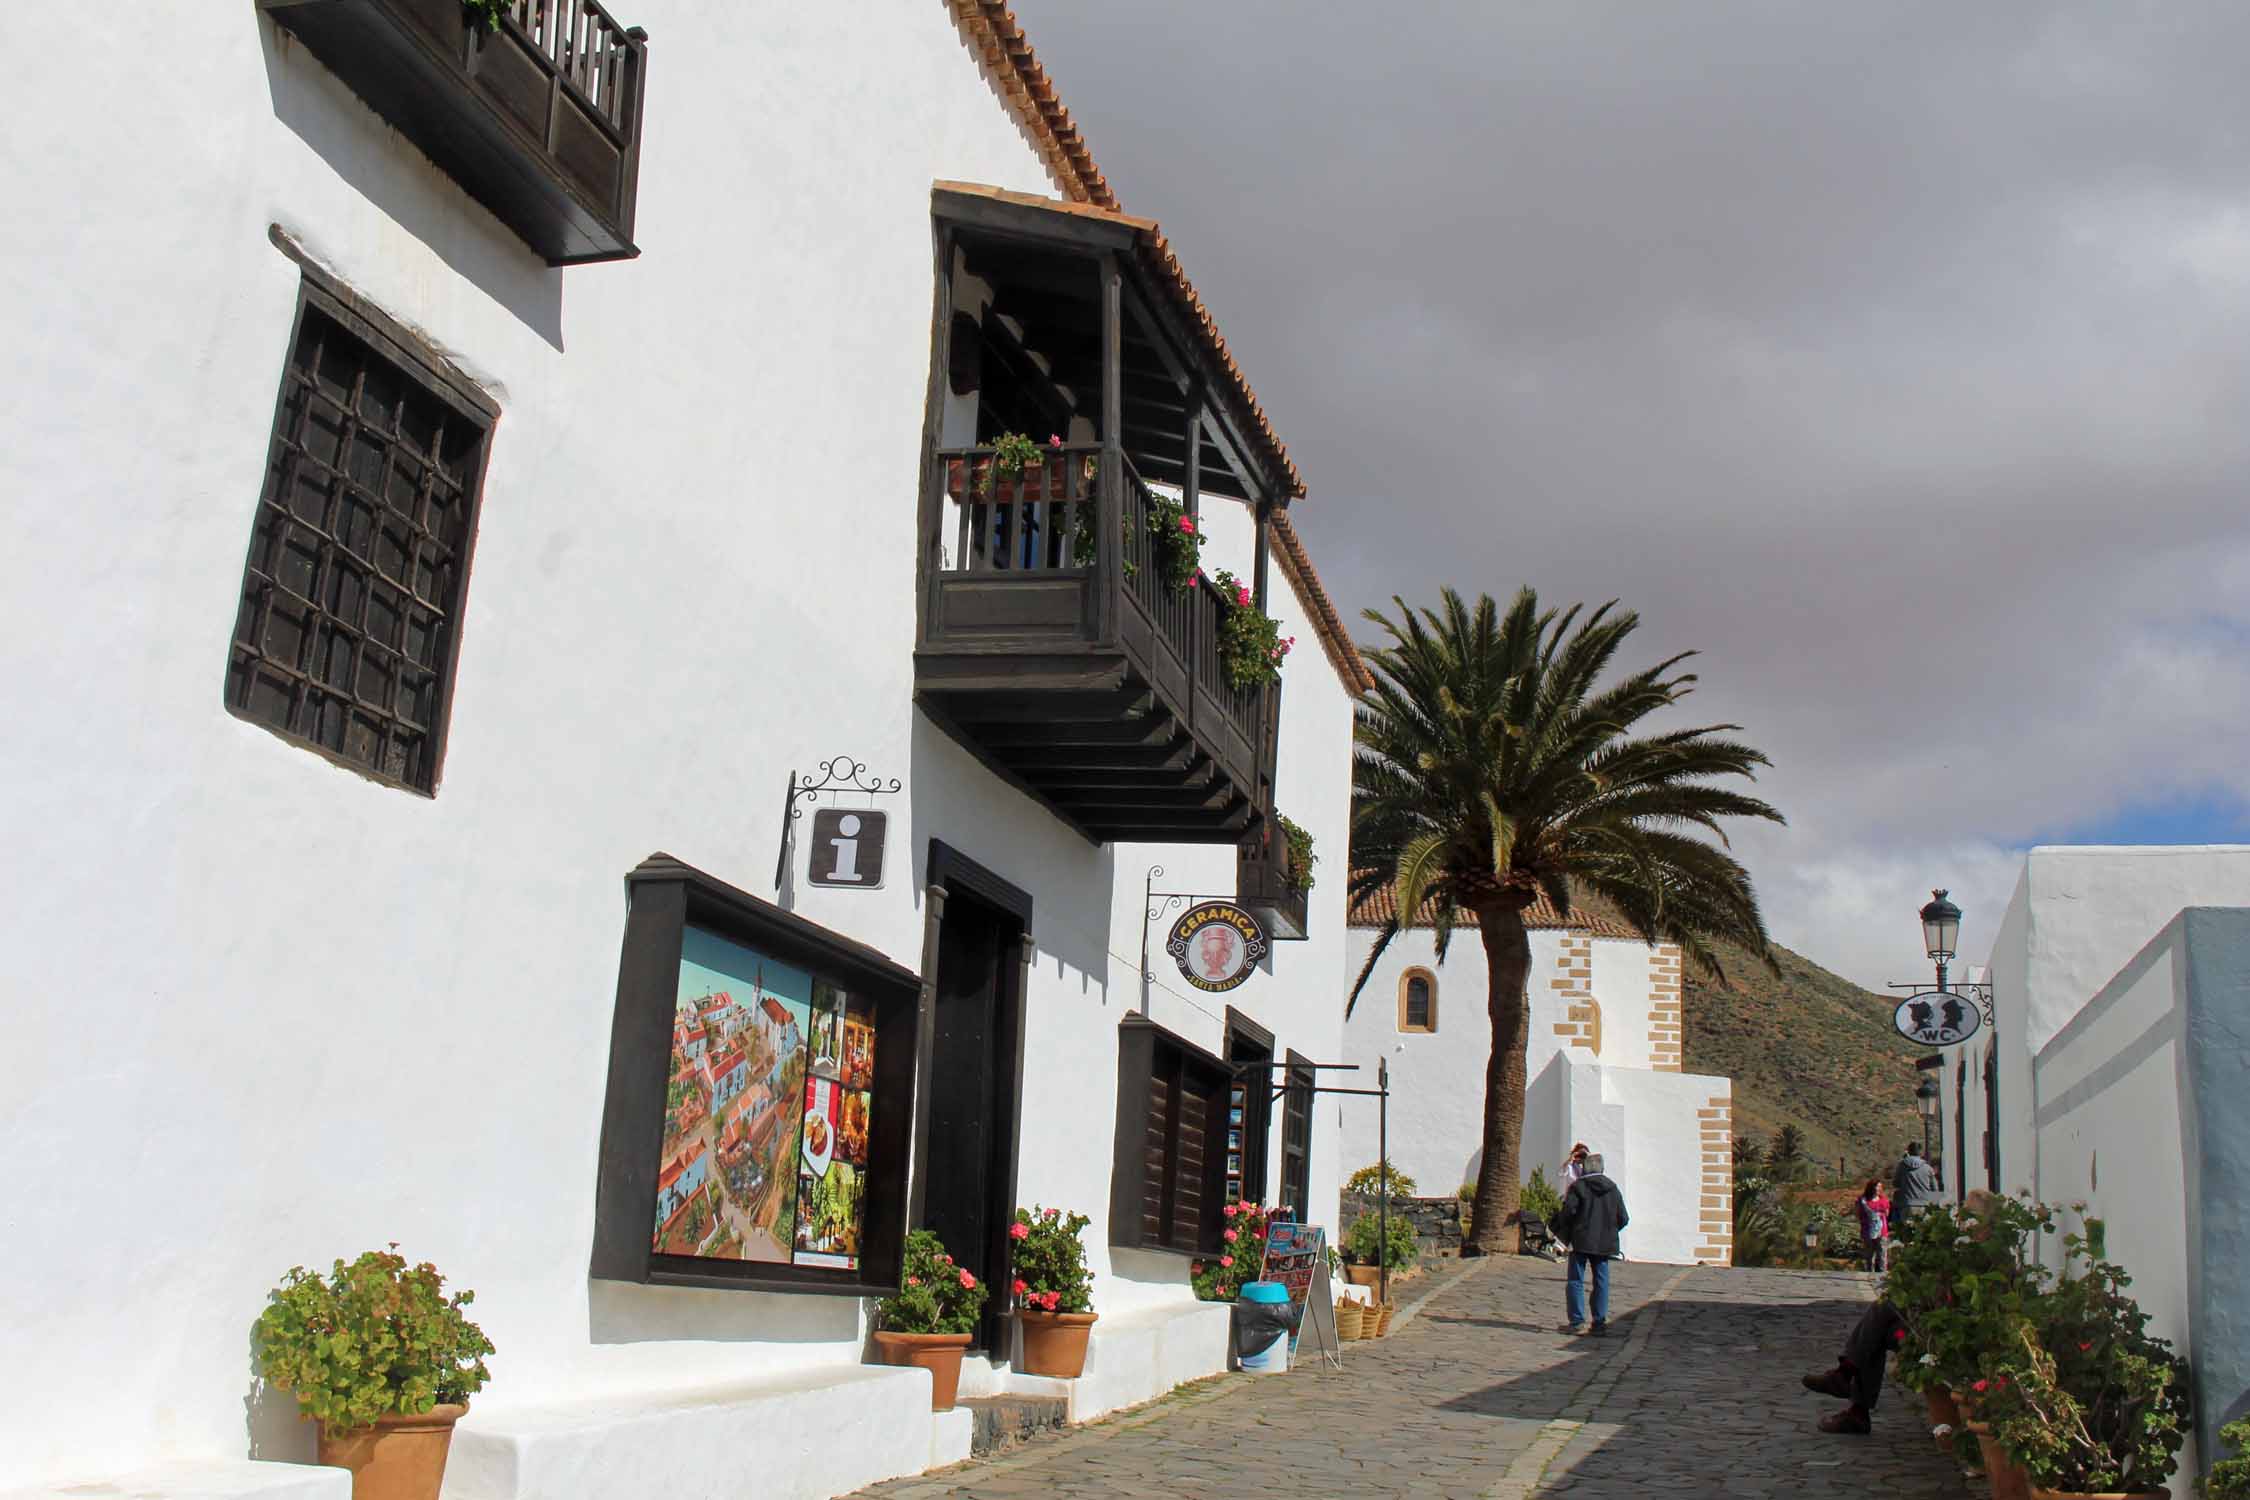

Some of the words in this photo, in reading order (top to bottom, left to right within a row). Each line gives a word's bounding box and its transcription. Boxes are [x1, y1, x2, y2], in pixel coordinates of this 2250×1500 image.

[826, 814, 863, 881] i
[1180, 908, 1255, 938] CERAMICA
[1922, 1030, 1951, 1042] WC
